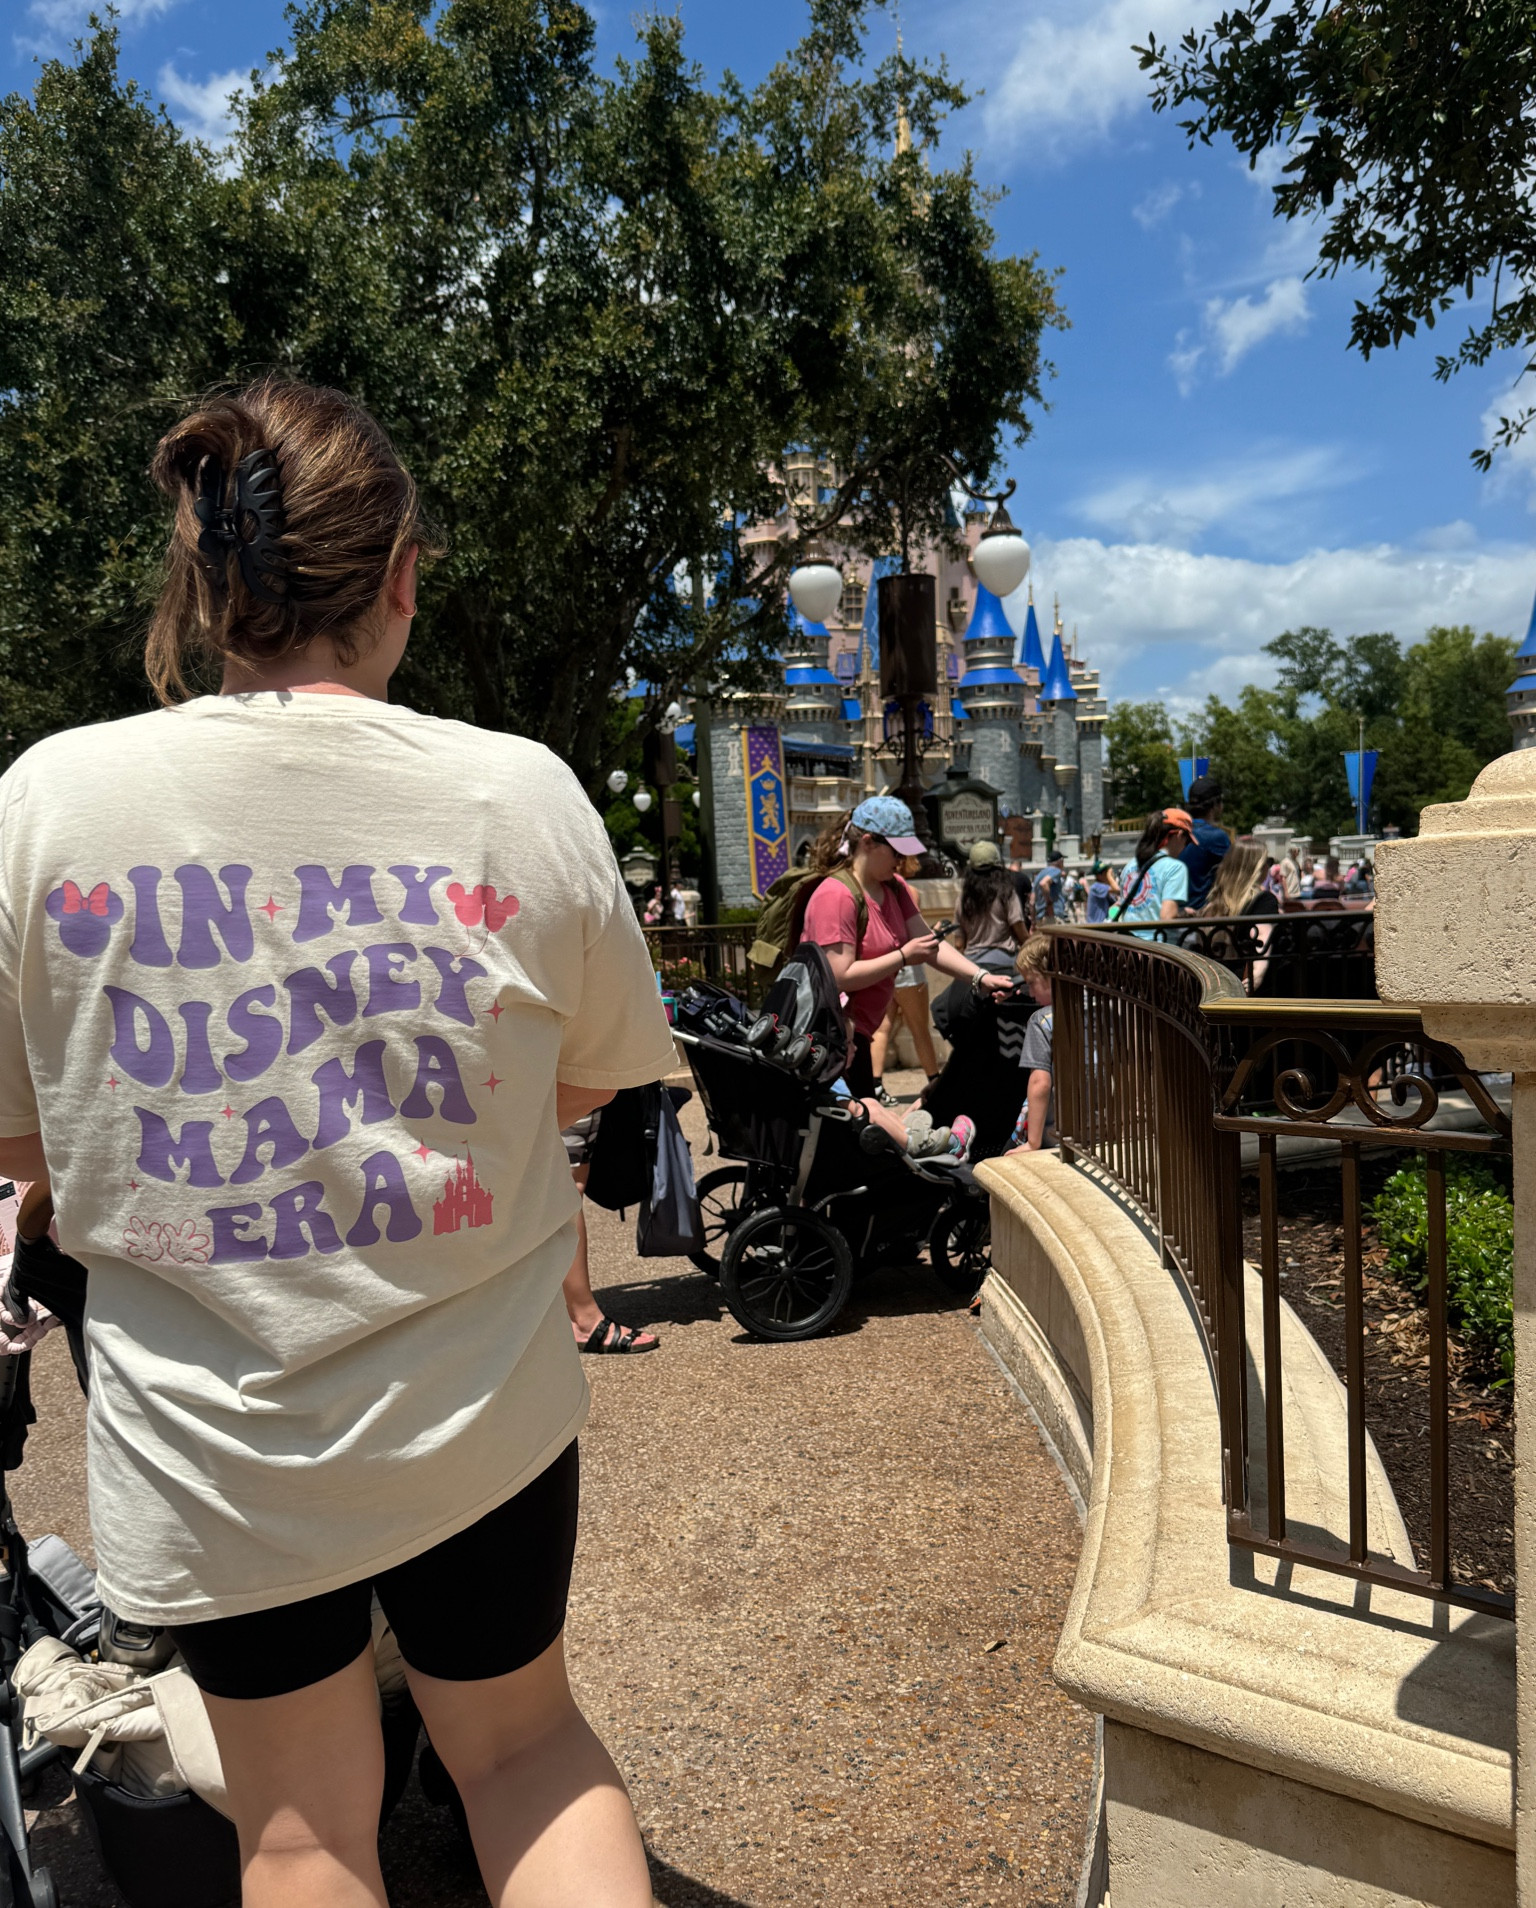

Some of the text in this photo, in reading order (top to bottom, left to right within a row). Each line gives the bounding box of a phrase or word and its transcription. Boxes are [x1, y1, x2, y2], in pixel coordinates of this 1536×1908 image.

[945, 809, 991, 820] ADVENTURELAND
[127, 864, 453, 970] IN MY
[103, 942, 488, 1095] DISNEY
[132, 1035, 478, 1188] MAMA
[205, 1150, 423, 1265] ERA
